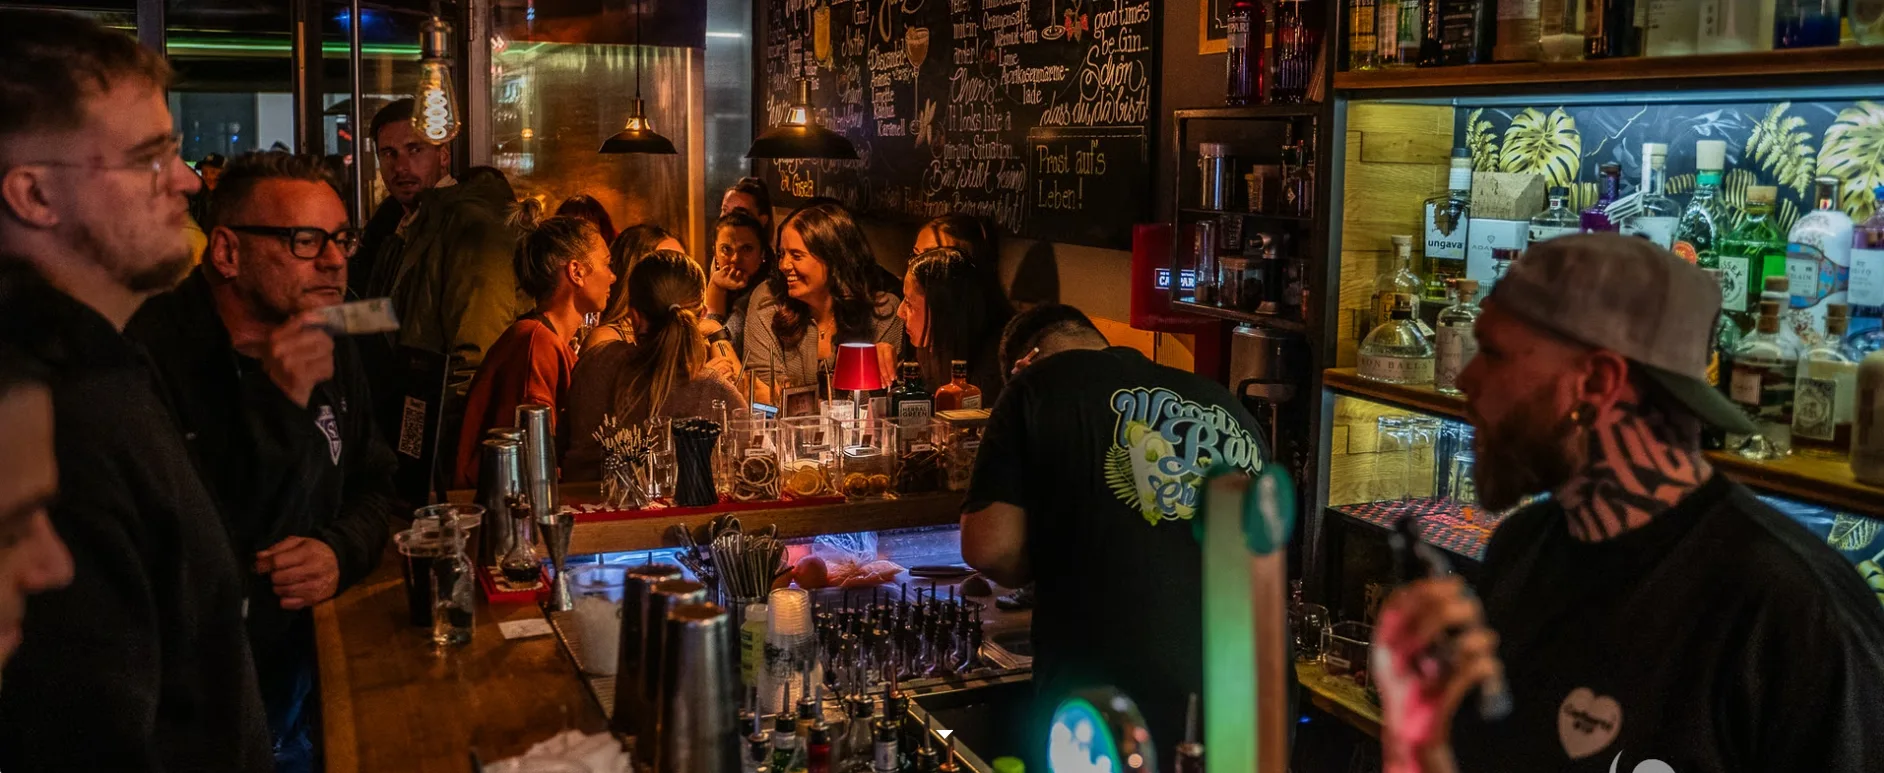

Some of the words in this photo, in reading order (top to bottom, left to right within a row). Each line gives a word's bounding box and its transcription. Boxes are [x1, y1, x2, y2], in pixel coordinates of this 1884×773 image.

[1094, 0, 1118, 40] good
[1119, 0, 1151, 26] times
[1022, 84, 1043, 105] lade
[1039, 91, 1070, 126] dass
[959, 103, 982, 132] looks
[983, 104, 1003, 132] like
[1004, 110, 1012, 131] a
[1036, 145, 1070, 174] Prost
[1038, 177, 1083, 210] Leben!
[1428, 239, 1463, 249] ungava
[1158, 417, 1263, 478] Bar
